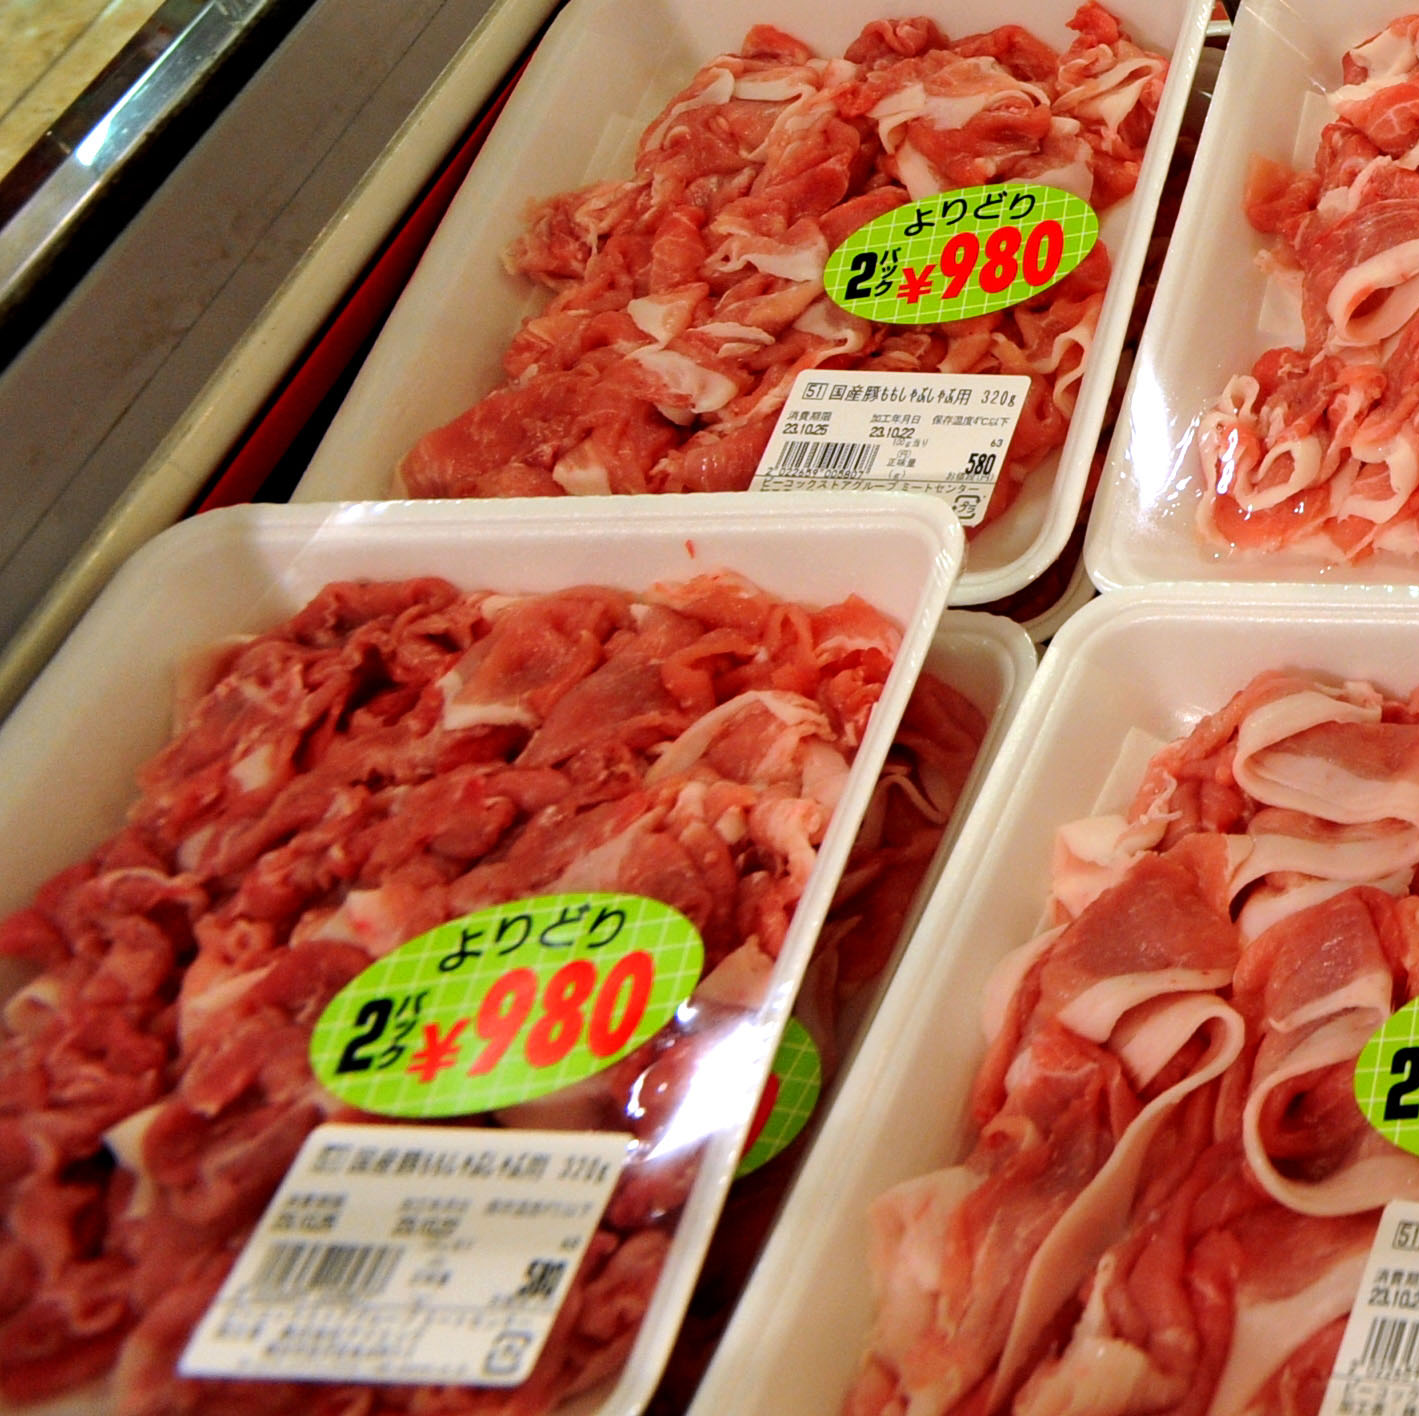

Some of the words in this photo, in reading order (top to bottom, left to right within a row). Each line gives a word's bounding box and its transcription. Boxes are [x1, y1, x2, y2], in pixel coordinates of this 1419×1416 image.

[903, 189, 1037, 237] よりどり
[829, 385, 972, 405] 国産豚ももしゃぶしゃぶ用
[981, 390, 1017, 407] 320g
[783, 424, 829, 434] 23.10.25
[869, 427, 915, 438] 23.10.22
[965, 454, 995, 474] 580
[437, 902, 627, 972] よりどり
